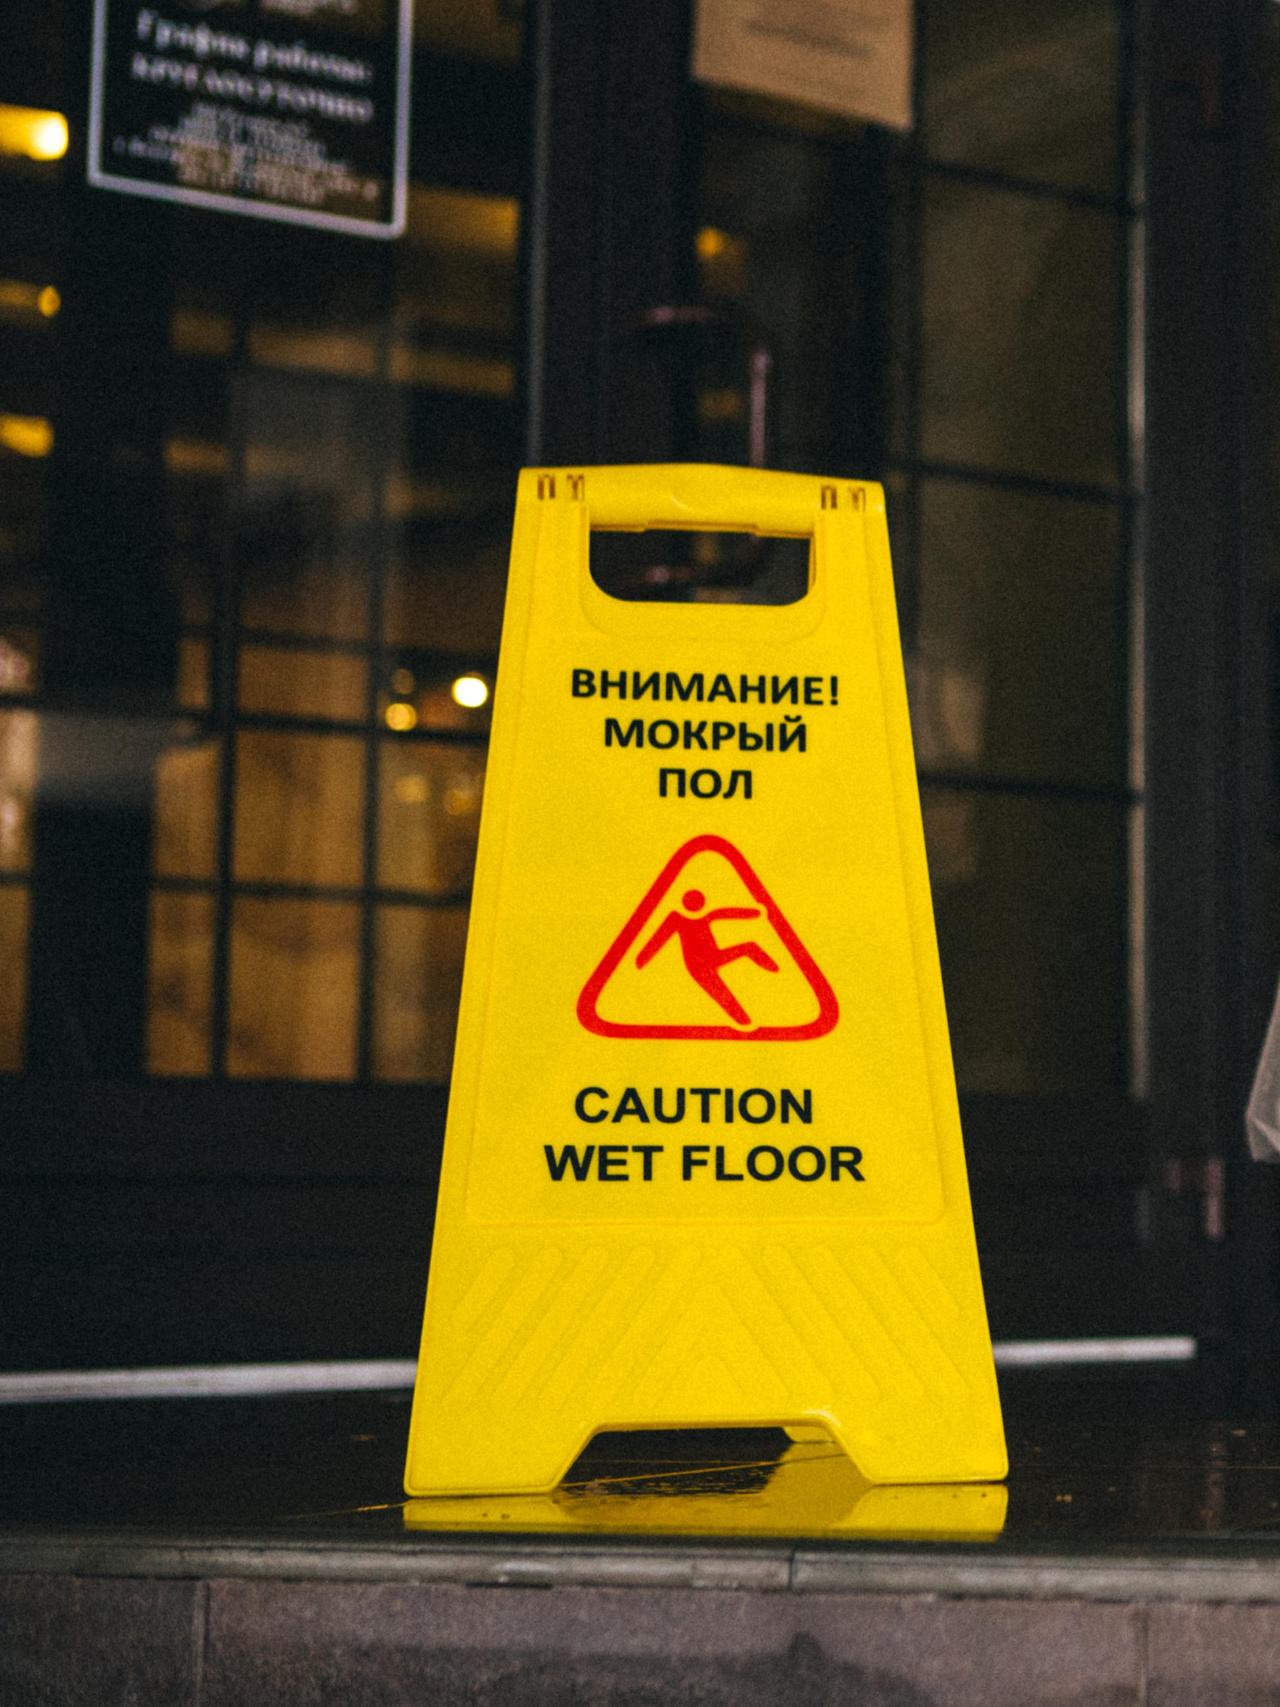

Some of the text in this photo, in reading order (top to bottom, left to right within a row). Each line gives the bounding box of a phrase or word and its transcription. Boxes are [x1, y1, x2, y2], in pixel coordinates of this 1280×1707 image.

[572, 669, 838, 705] ВНИМАНИЕ!
[605, 715, 806, 752] МОКРЫЙ
[660, 768, 752, 799] ПОЛ
[575, 1087, 812, 1124] CAUTION
[544, 1145, 865, 1182] WET FLOOR
